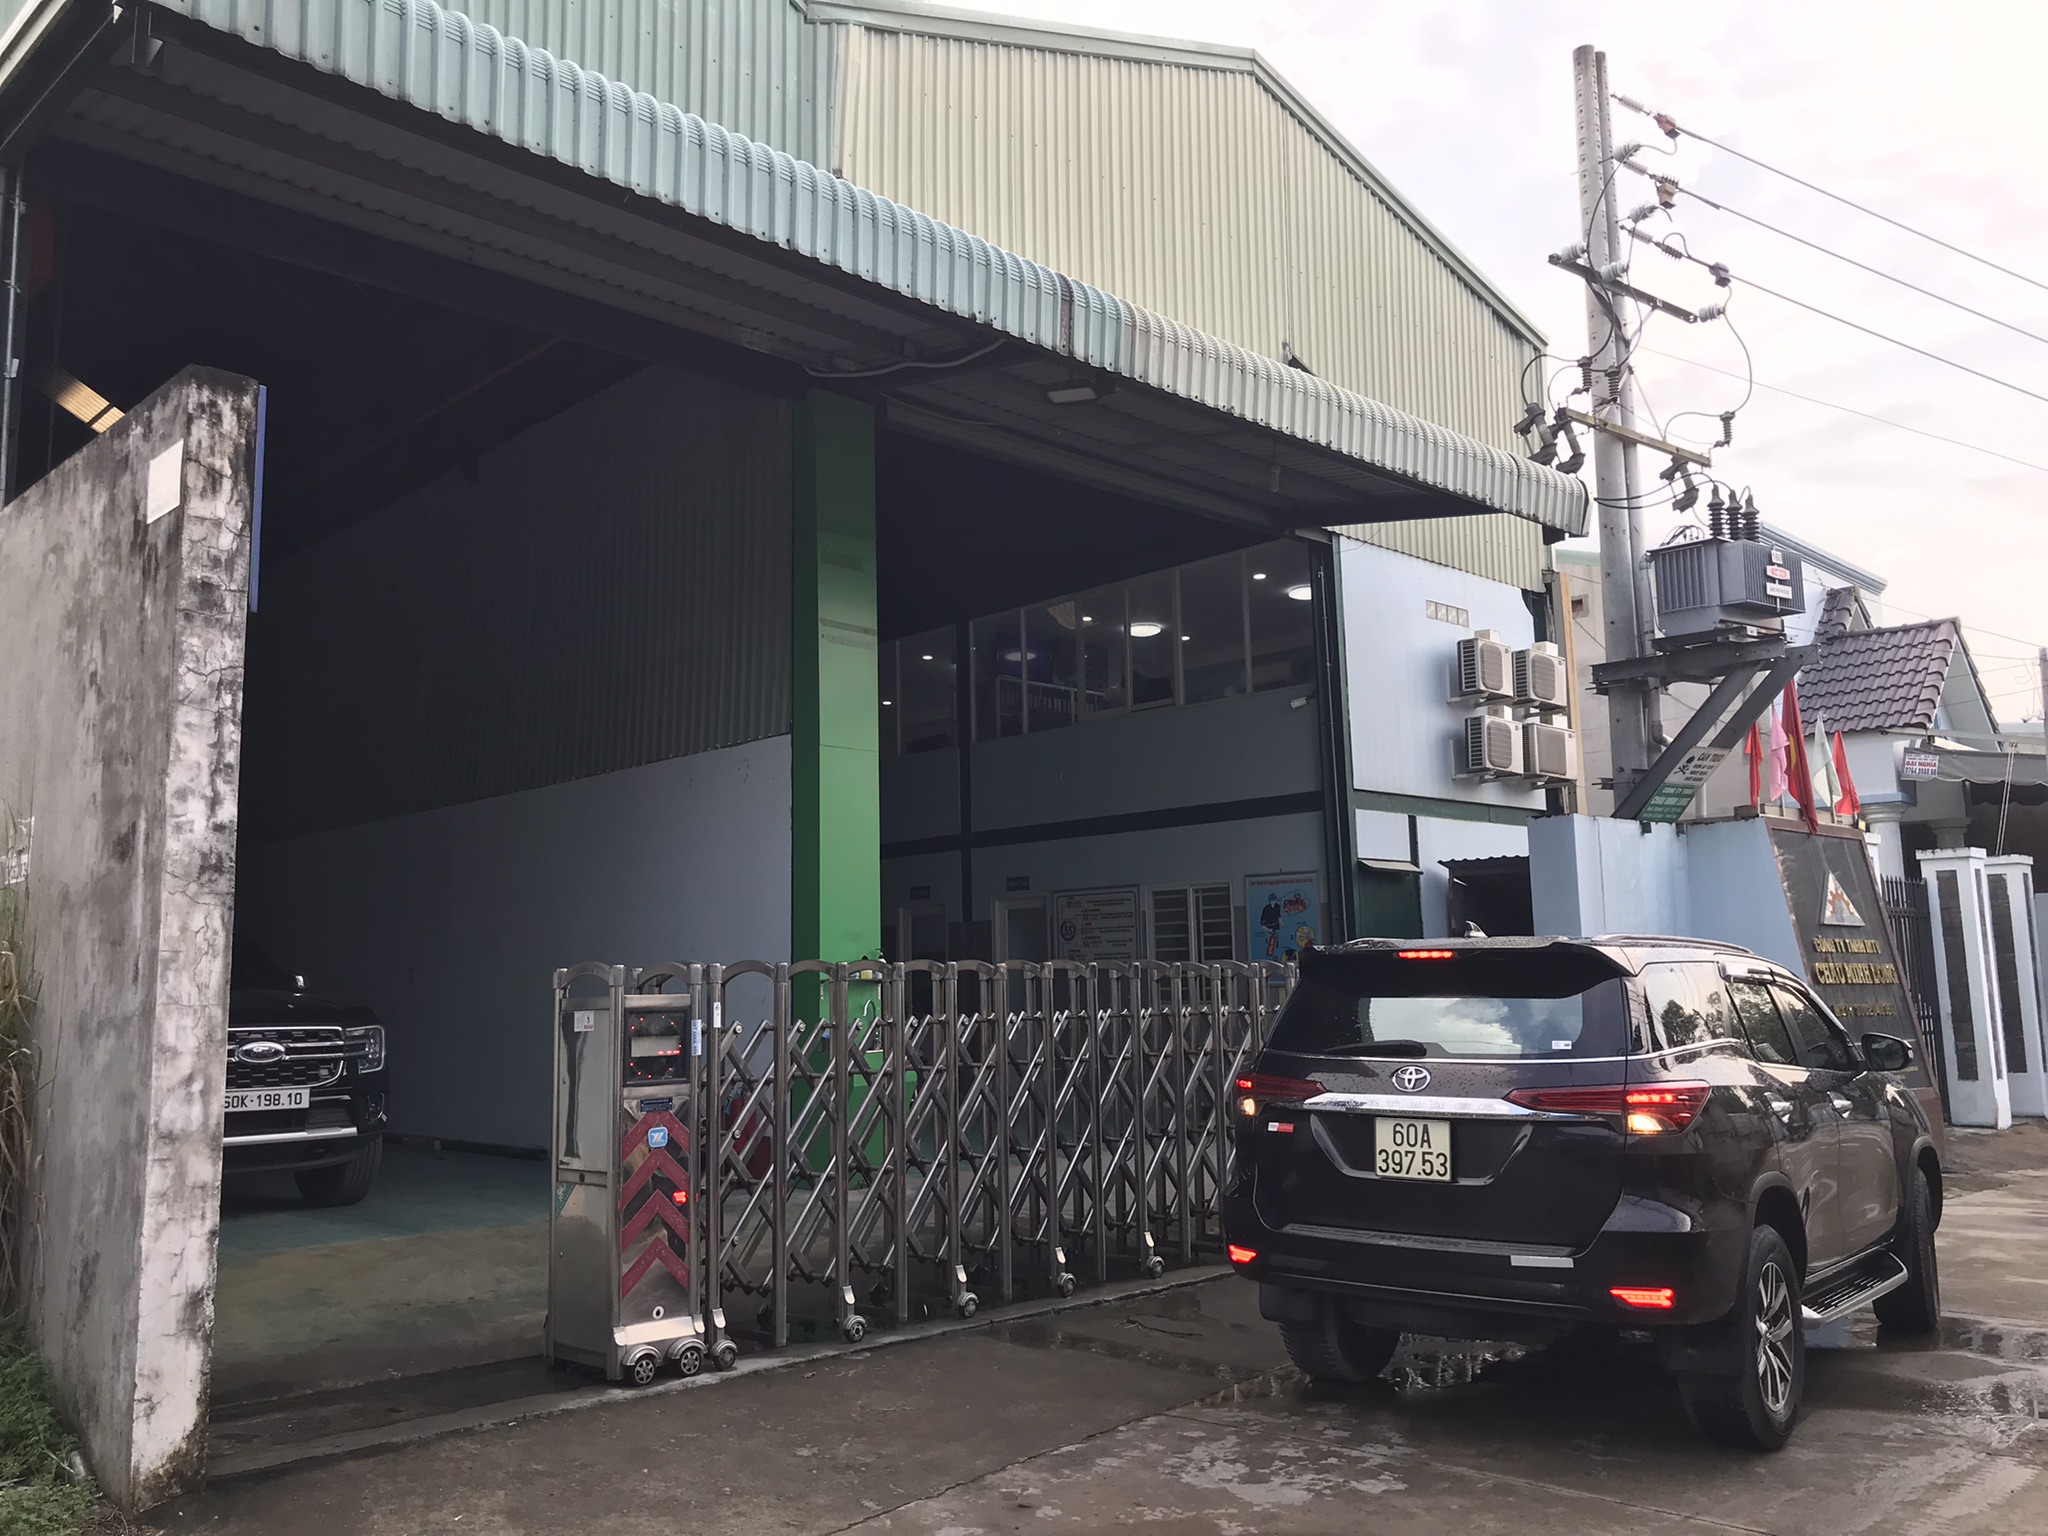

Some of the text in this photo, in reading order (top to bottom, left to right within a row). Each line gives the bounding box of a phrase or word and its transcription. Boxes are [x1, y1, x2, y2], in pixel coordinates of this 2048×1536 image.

[1871, 964, 1899, 985] LONG
[1392, 1122, 1432, 1149] 60A
[1378, 1148, 1448, 1177] 397.53
